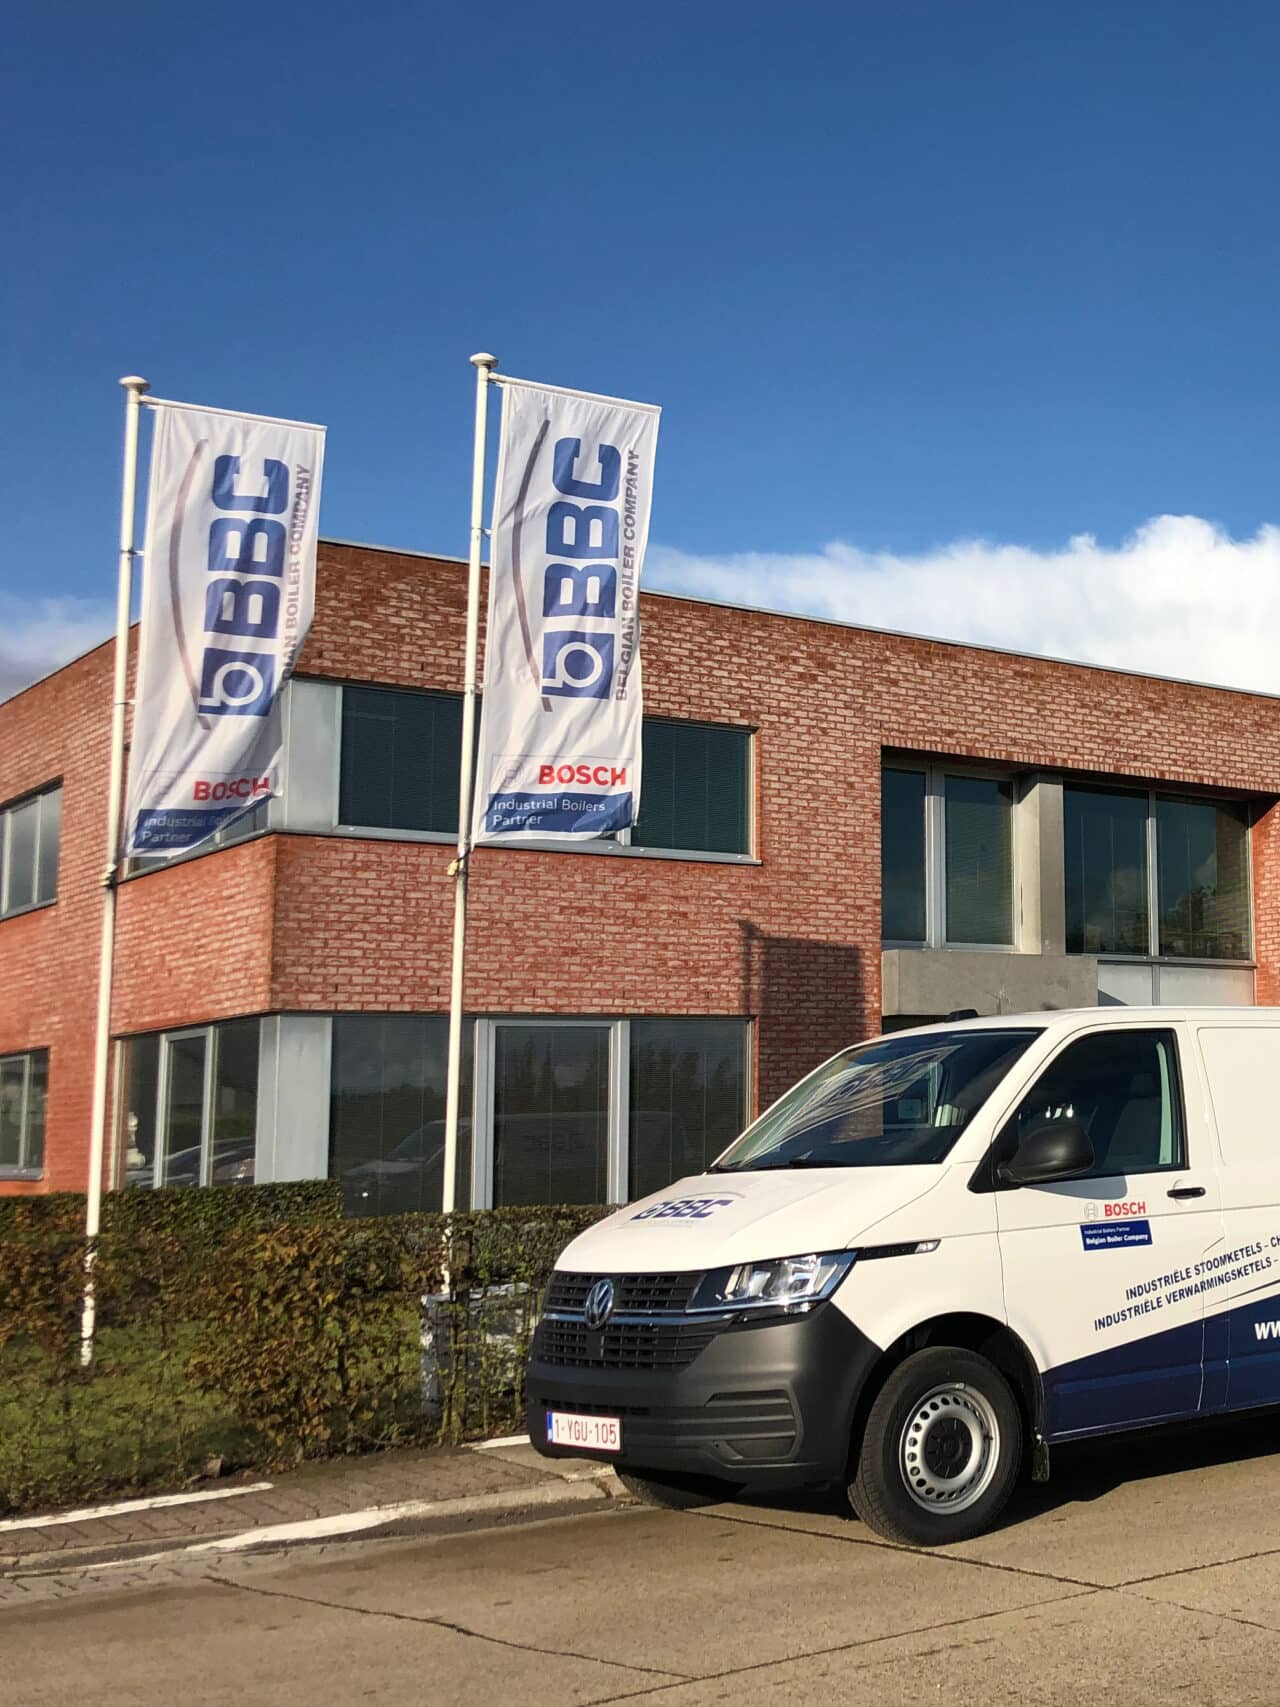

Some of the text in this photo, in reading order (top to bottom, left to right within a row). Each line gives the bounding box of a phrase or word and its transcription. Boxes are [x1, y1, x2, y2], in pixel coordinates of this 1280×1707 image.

[290, 464, 311, 556] COMPANY
[616, 449, 641, 700] BELGIAN BOILER COMPANY
[286, 560, 300, 629] BOILER
[538, 764, 627, 787] BOSCH
[193, 777, 269, 800] BOSCH
[494, 799, 606, 812] Industrial Boilers
[493, 814, 543, 826] Partner
[142, 831, 193, 843] Partner
[1104, 1202, 1146, 1217] BOSCH
[1194, 1242, 1263, 1277] STOOMKETELS
[1165, 1256, 1272, 1305] VERWARMINGSKETELS
